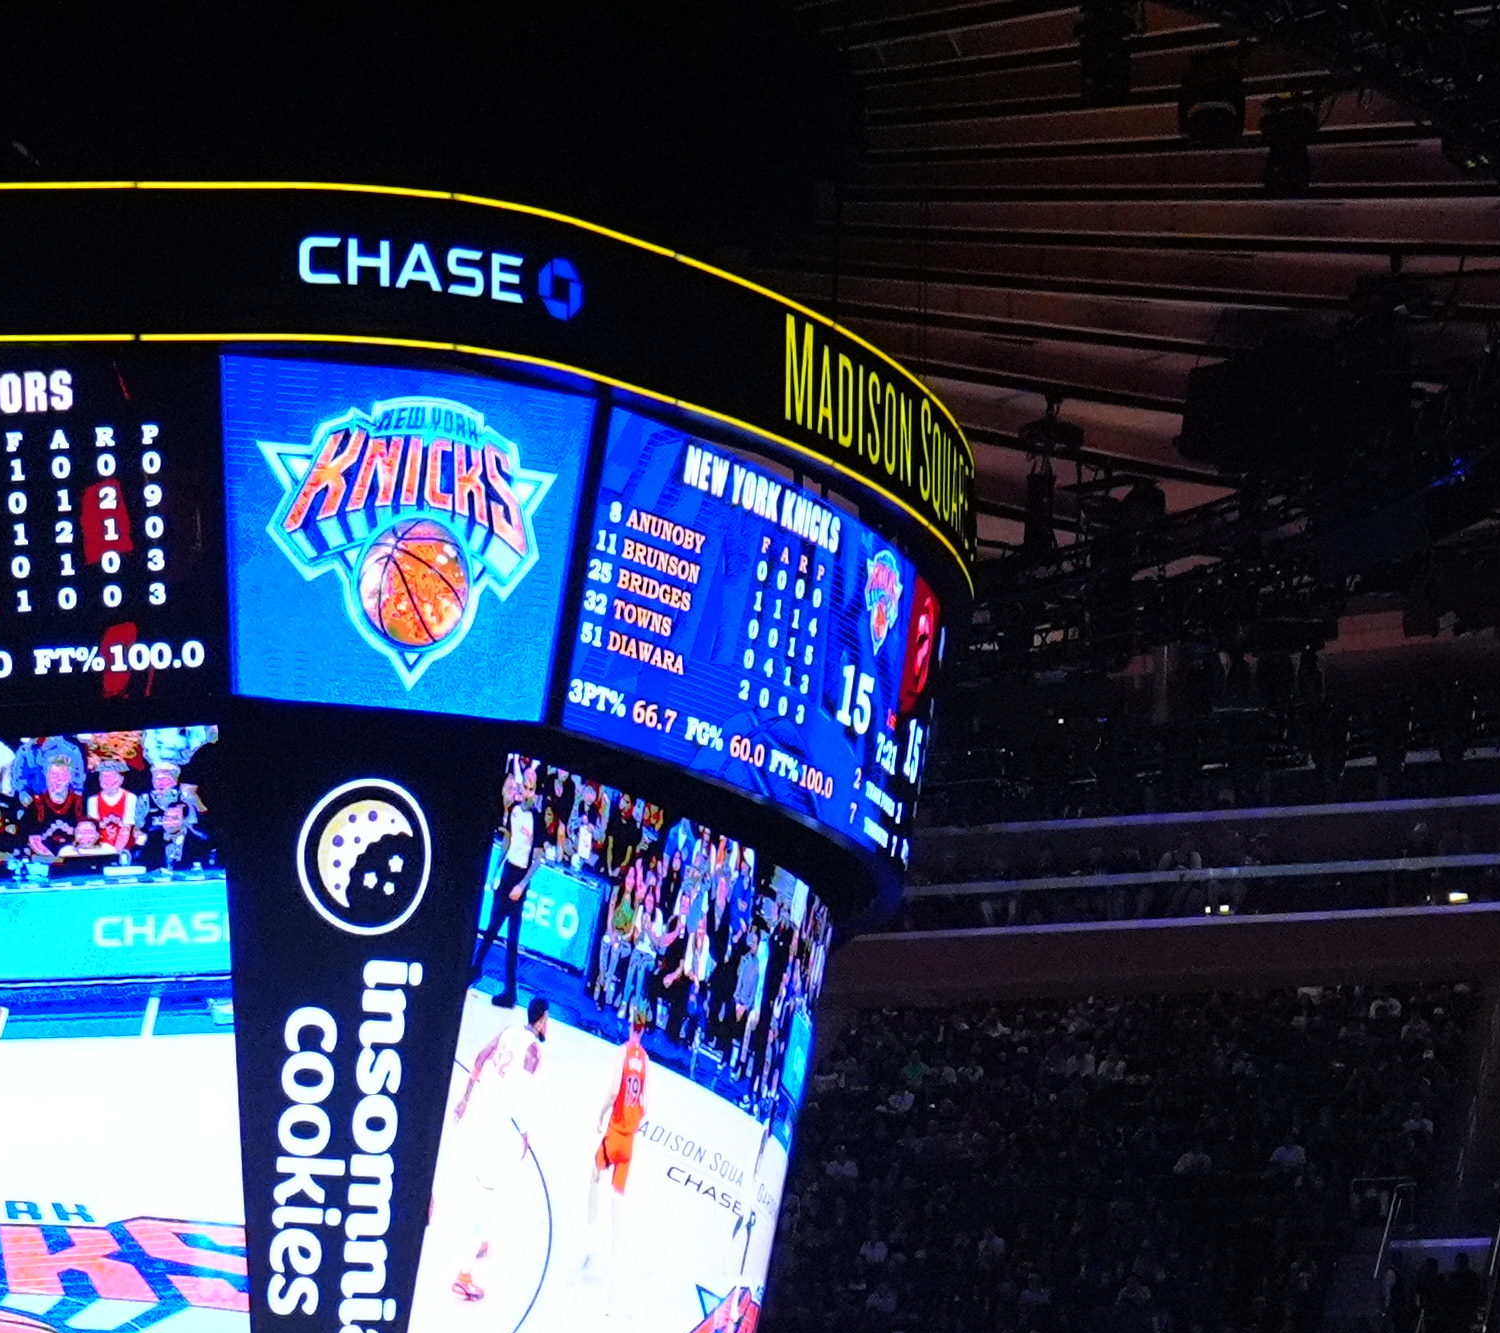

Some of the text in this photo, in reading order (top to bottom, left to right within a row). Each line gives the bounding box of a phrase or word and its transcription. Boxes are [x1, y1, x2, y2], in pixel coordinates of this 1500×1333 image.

[298, 235, 524, 305] CHASE
[784, 312, 912, 488] MADISON
[283, 425, 530, 556] KNICKS
[683, 445, 842, 554] NEW YORK KNICKS
[32, 646, 106, 676] FT%
[109, 639, 205, 673] 100.0
[836, 664, 877, 736] 15
[92, 911, 231, 947] CHAS
[266, 1004, 339, 1318] cookies
